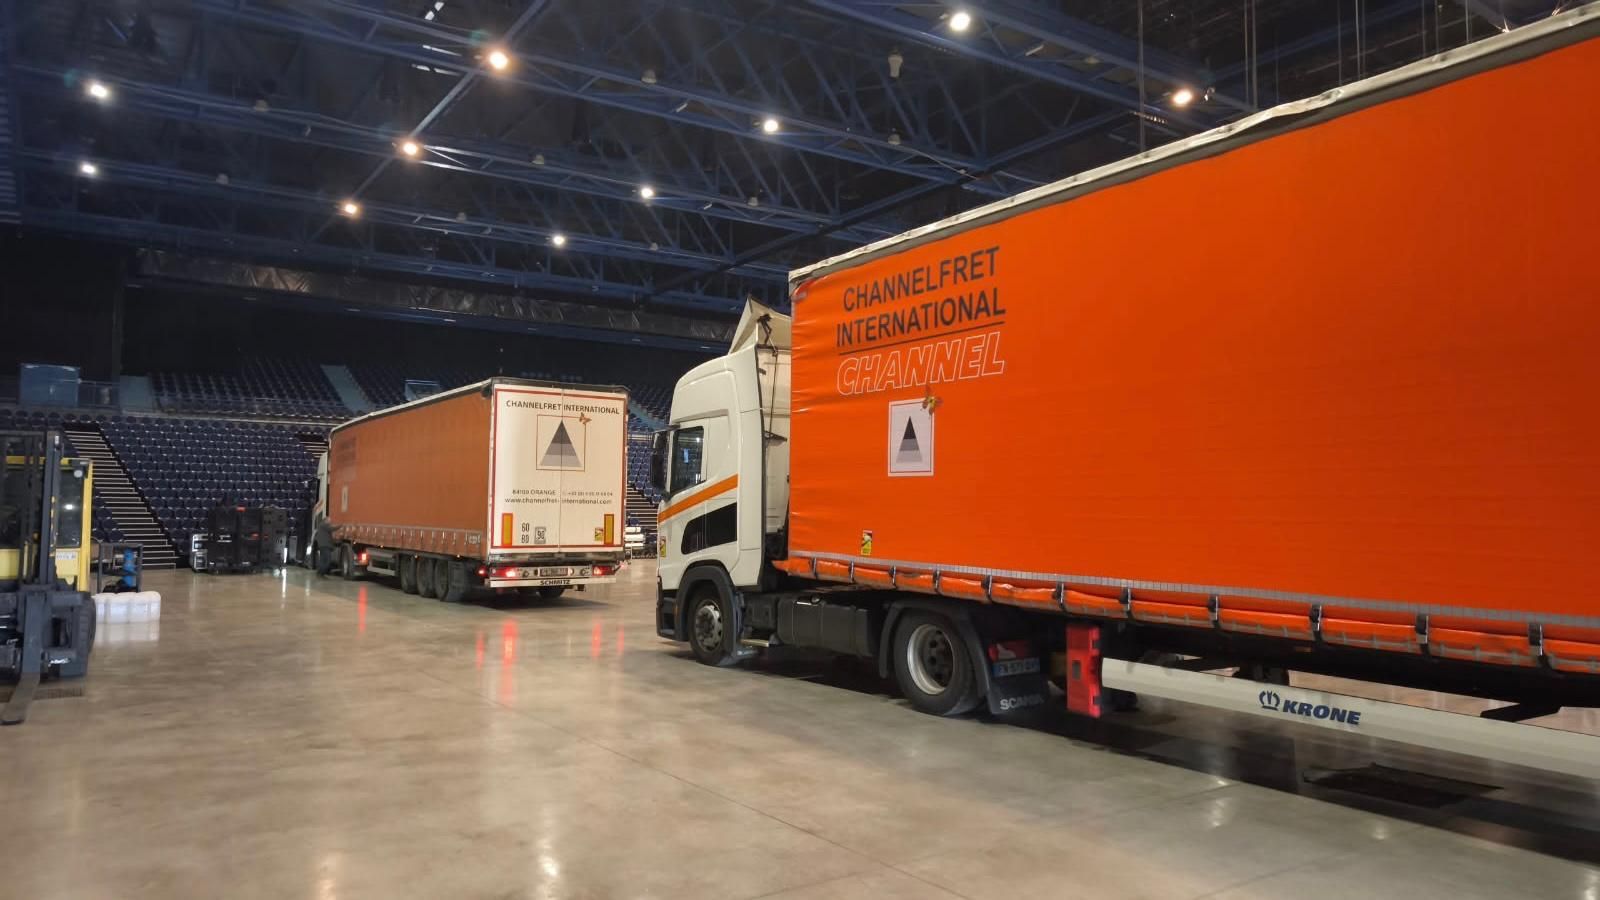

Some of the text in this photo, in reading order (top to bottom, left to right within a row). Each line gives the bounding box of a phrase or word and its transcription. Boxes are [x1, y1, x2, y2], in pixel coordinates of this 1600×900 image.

[843, 246, 1000, 312] CHANNELFRET
[836, 287, 1006, 348] INTERNATIONAL
[837, 331, 1005, 396] CHANNEL
[506, 400, 620, 415] CHANNELFRET INTERNATIONAL
[521, 522, 530, 533] 60
[1282, 699, 1361, 725] KRONE
